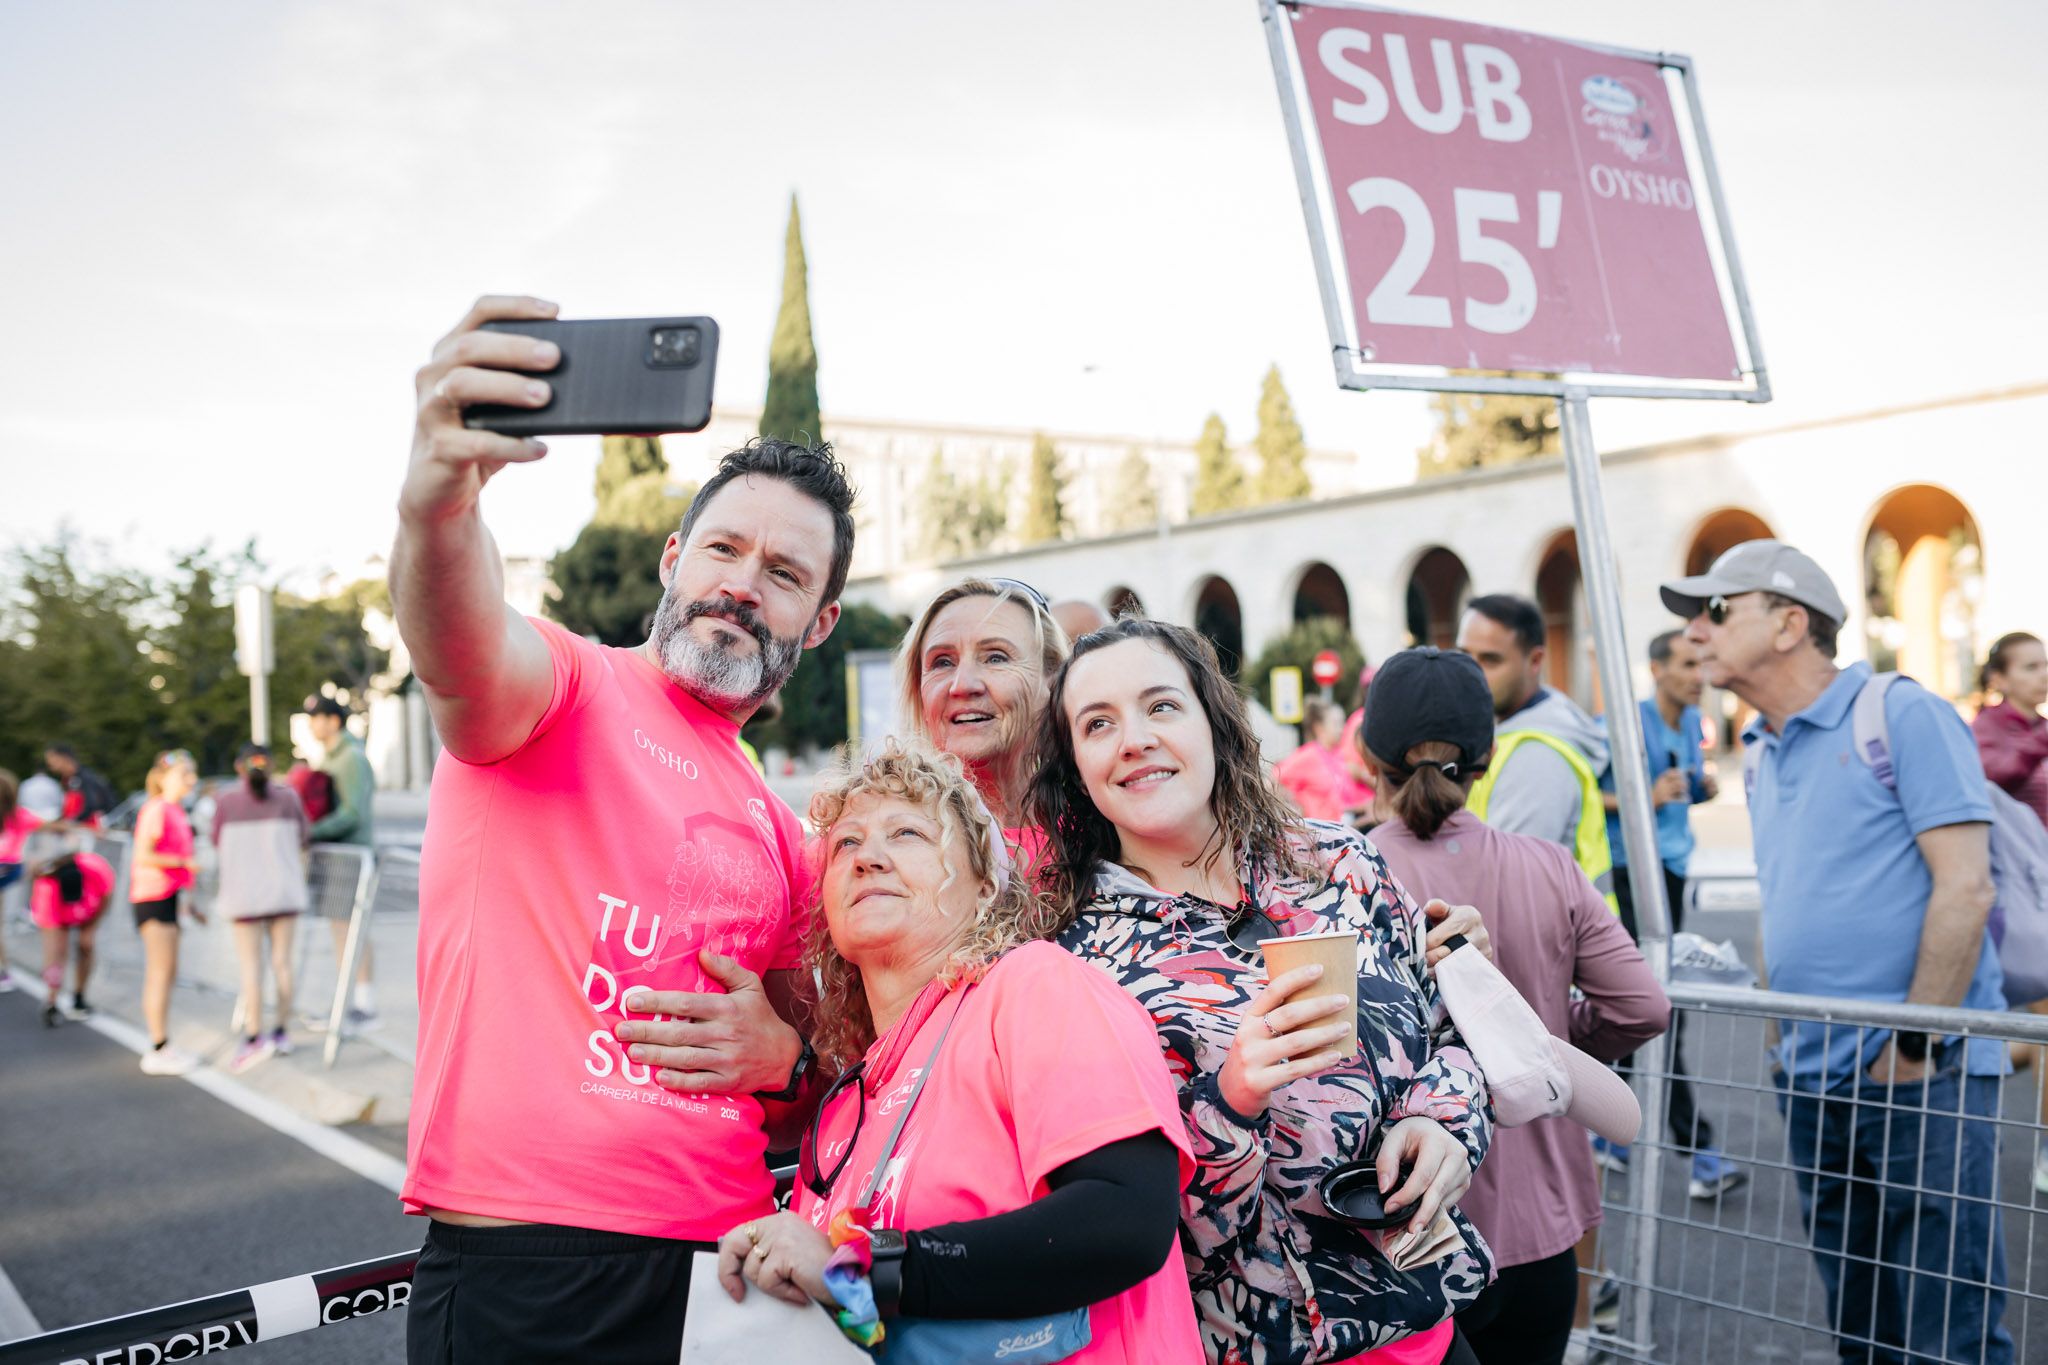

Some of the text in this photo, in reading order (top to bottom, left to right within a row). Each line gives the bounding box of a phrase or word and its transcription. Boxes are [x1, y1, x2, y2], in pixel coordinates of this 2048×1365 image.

[1318, 27, 1532, 142] SUB
[1590, 163, 1694, 211] OYSHO
[1347, 177, 1562, 334] 25'
[634, 729, 698, 780] OYSHO
[598, 893, 660, 957] TU
[580, 1082, 740, 1121] CARRERA DE LA MUJER 2023
[994, 1322, 1055, 1358] Sport
